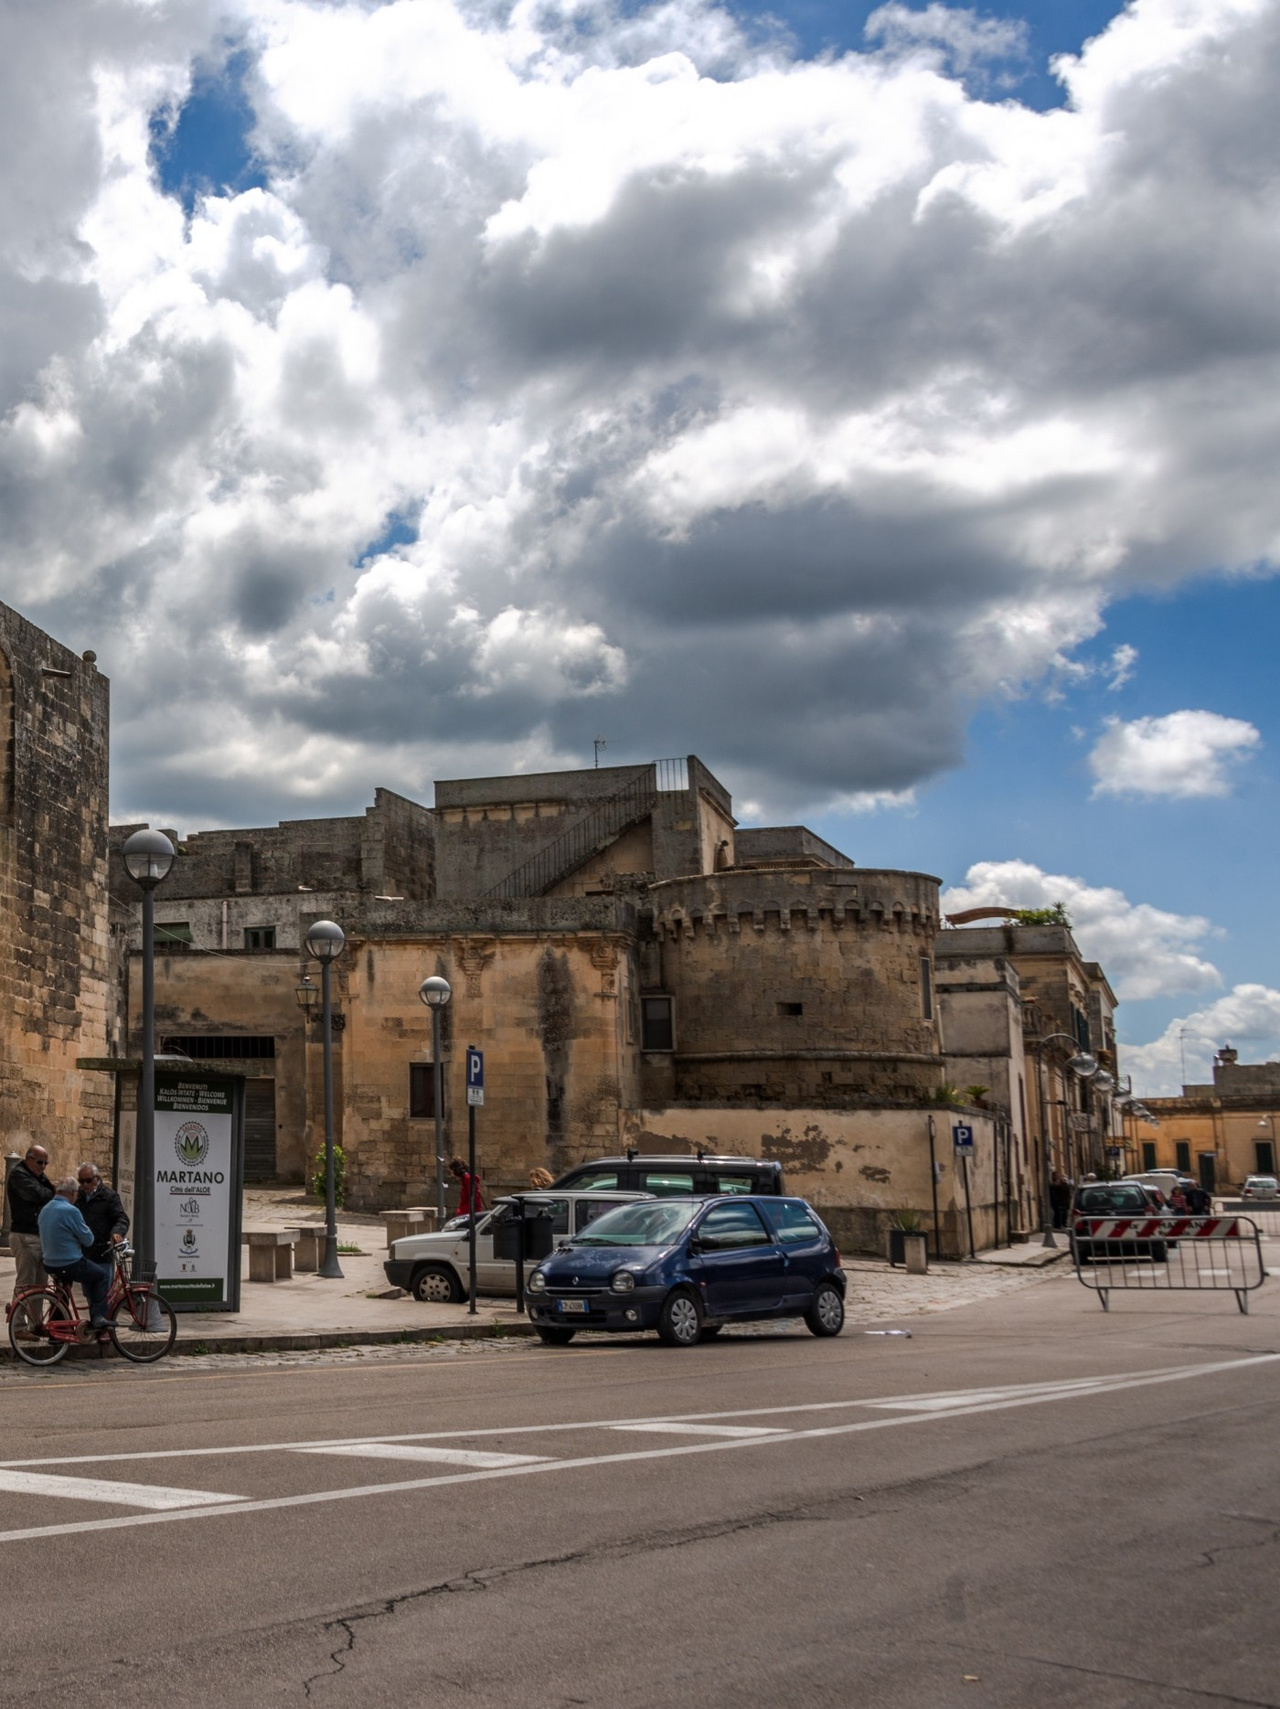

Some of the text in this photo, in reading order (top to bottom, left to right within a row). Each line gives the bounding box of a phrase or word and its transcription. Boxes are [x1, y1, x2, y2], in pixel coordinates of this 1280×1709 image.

[471, 1054, 481, 1082] P
[178, 1082, 208, 1090] BENVENUTI
[199, 1090, 225, 1098] WELCOME
[157, 1095, 195, 1103] WILLKOMMEN
[198, 1097, 227, 1105] BIENVENUE
[173, 1102, 209, 1111] BIENVENIDOS
[957, 1128, 969, 1144] P
[156, 1170, 224, 1184] MARTANO
